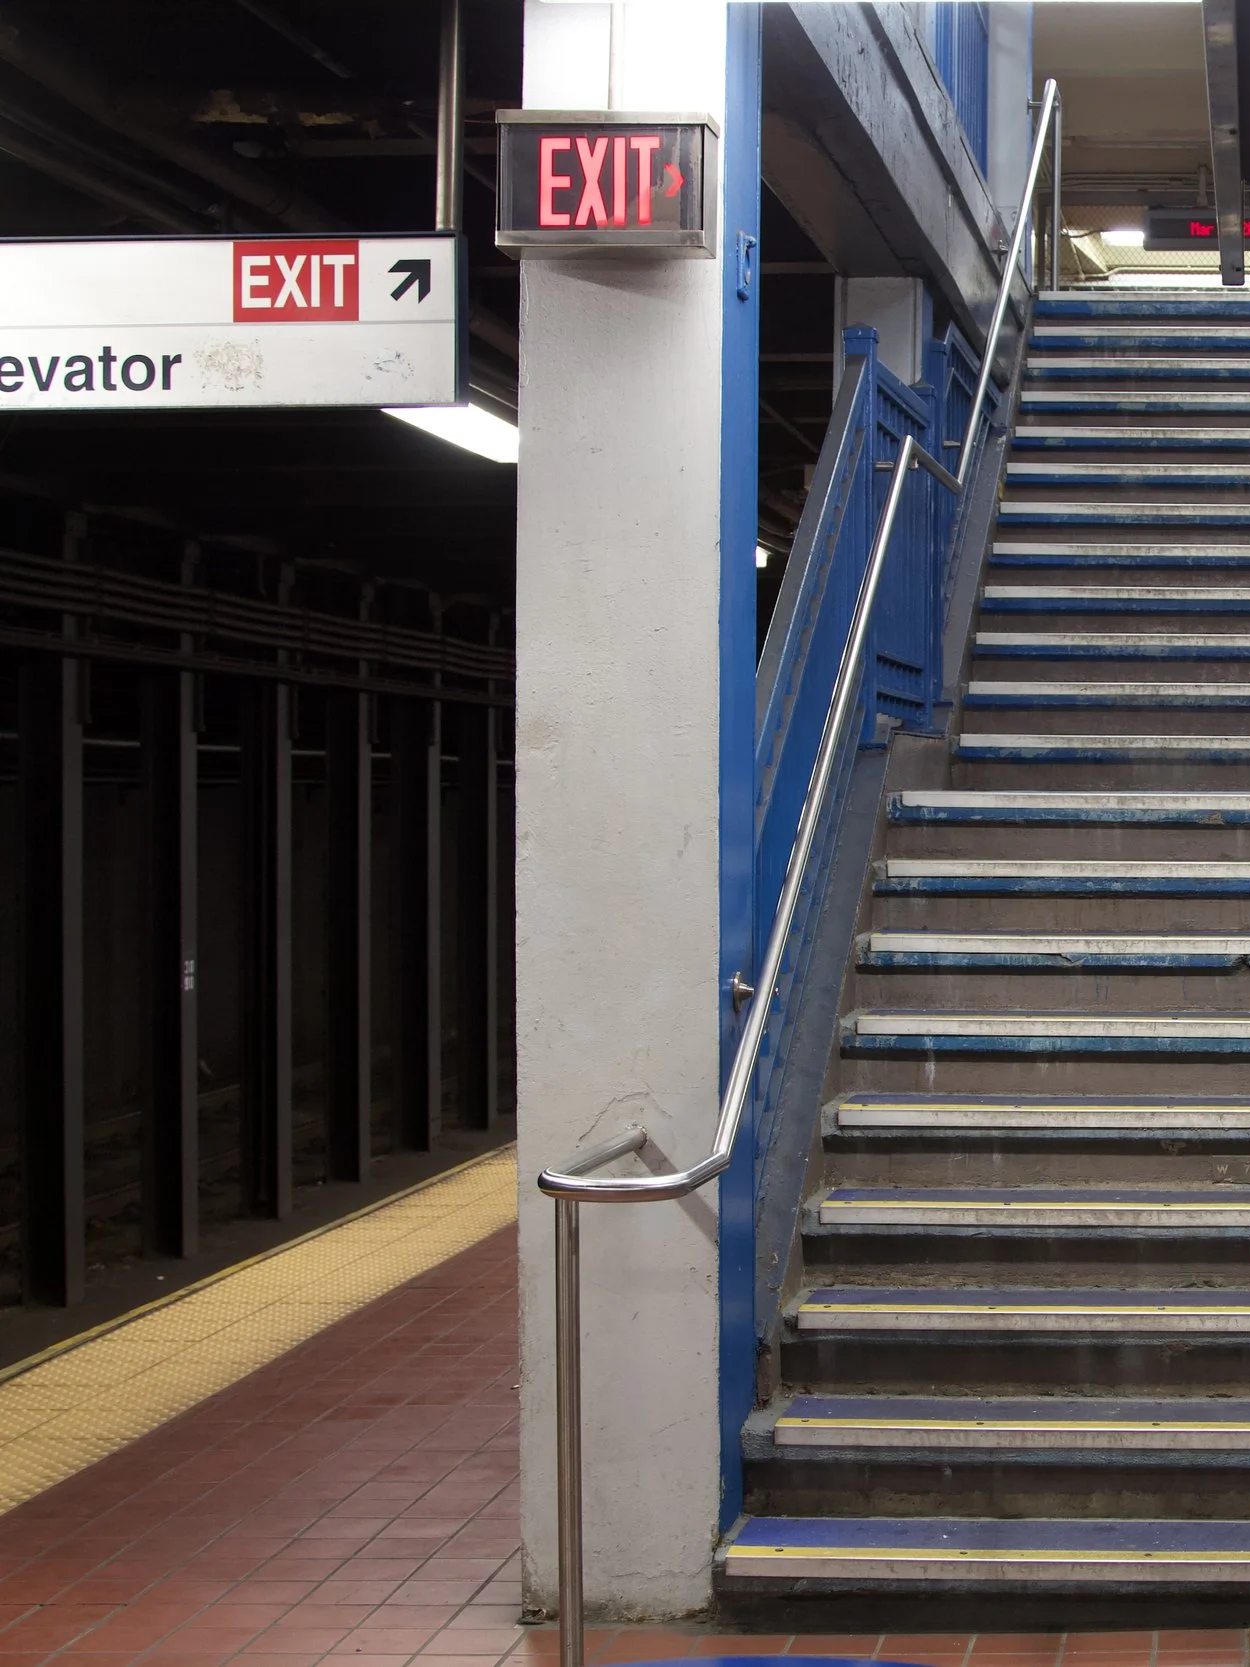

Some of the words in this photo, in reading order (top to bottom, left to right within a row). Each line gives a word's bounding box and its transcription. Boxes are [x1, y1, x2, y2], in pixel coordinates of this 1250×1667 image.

[539, 136, 660, 227] EXIT
[1190, 221, 1214, 235] Mar
[241, 254, 355, 308] EXIT
[0, 346, 182, 393] evator
[1216, 1164, 1229, 1175] W
